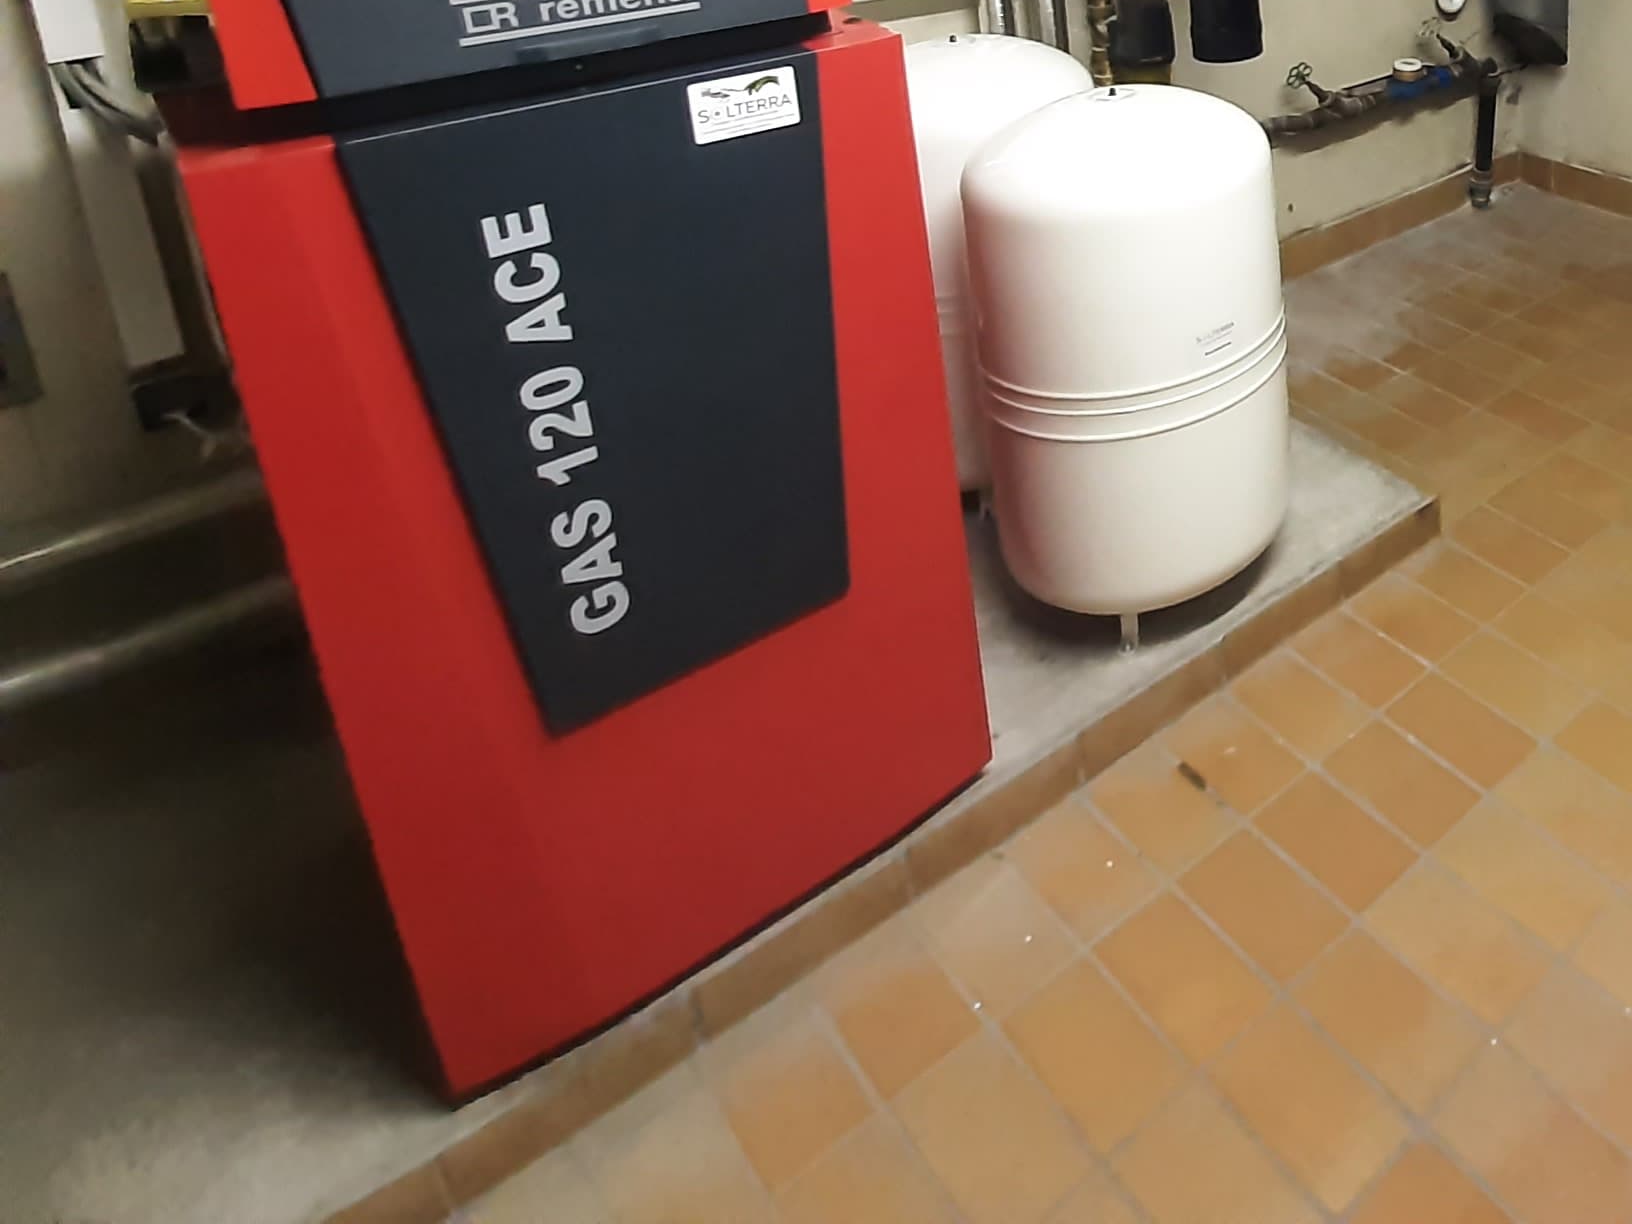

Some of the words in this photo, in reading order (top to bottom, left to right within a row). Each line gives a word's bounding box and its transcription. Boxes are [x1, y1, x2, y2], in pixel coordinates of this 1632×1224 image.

[480, 202, 574, 343] ACE
[519, 365, 599, 486] 120
[550, 499, 630, 635] GAS
